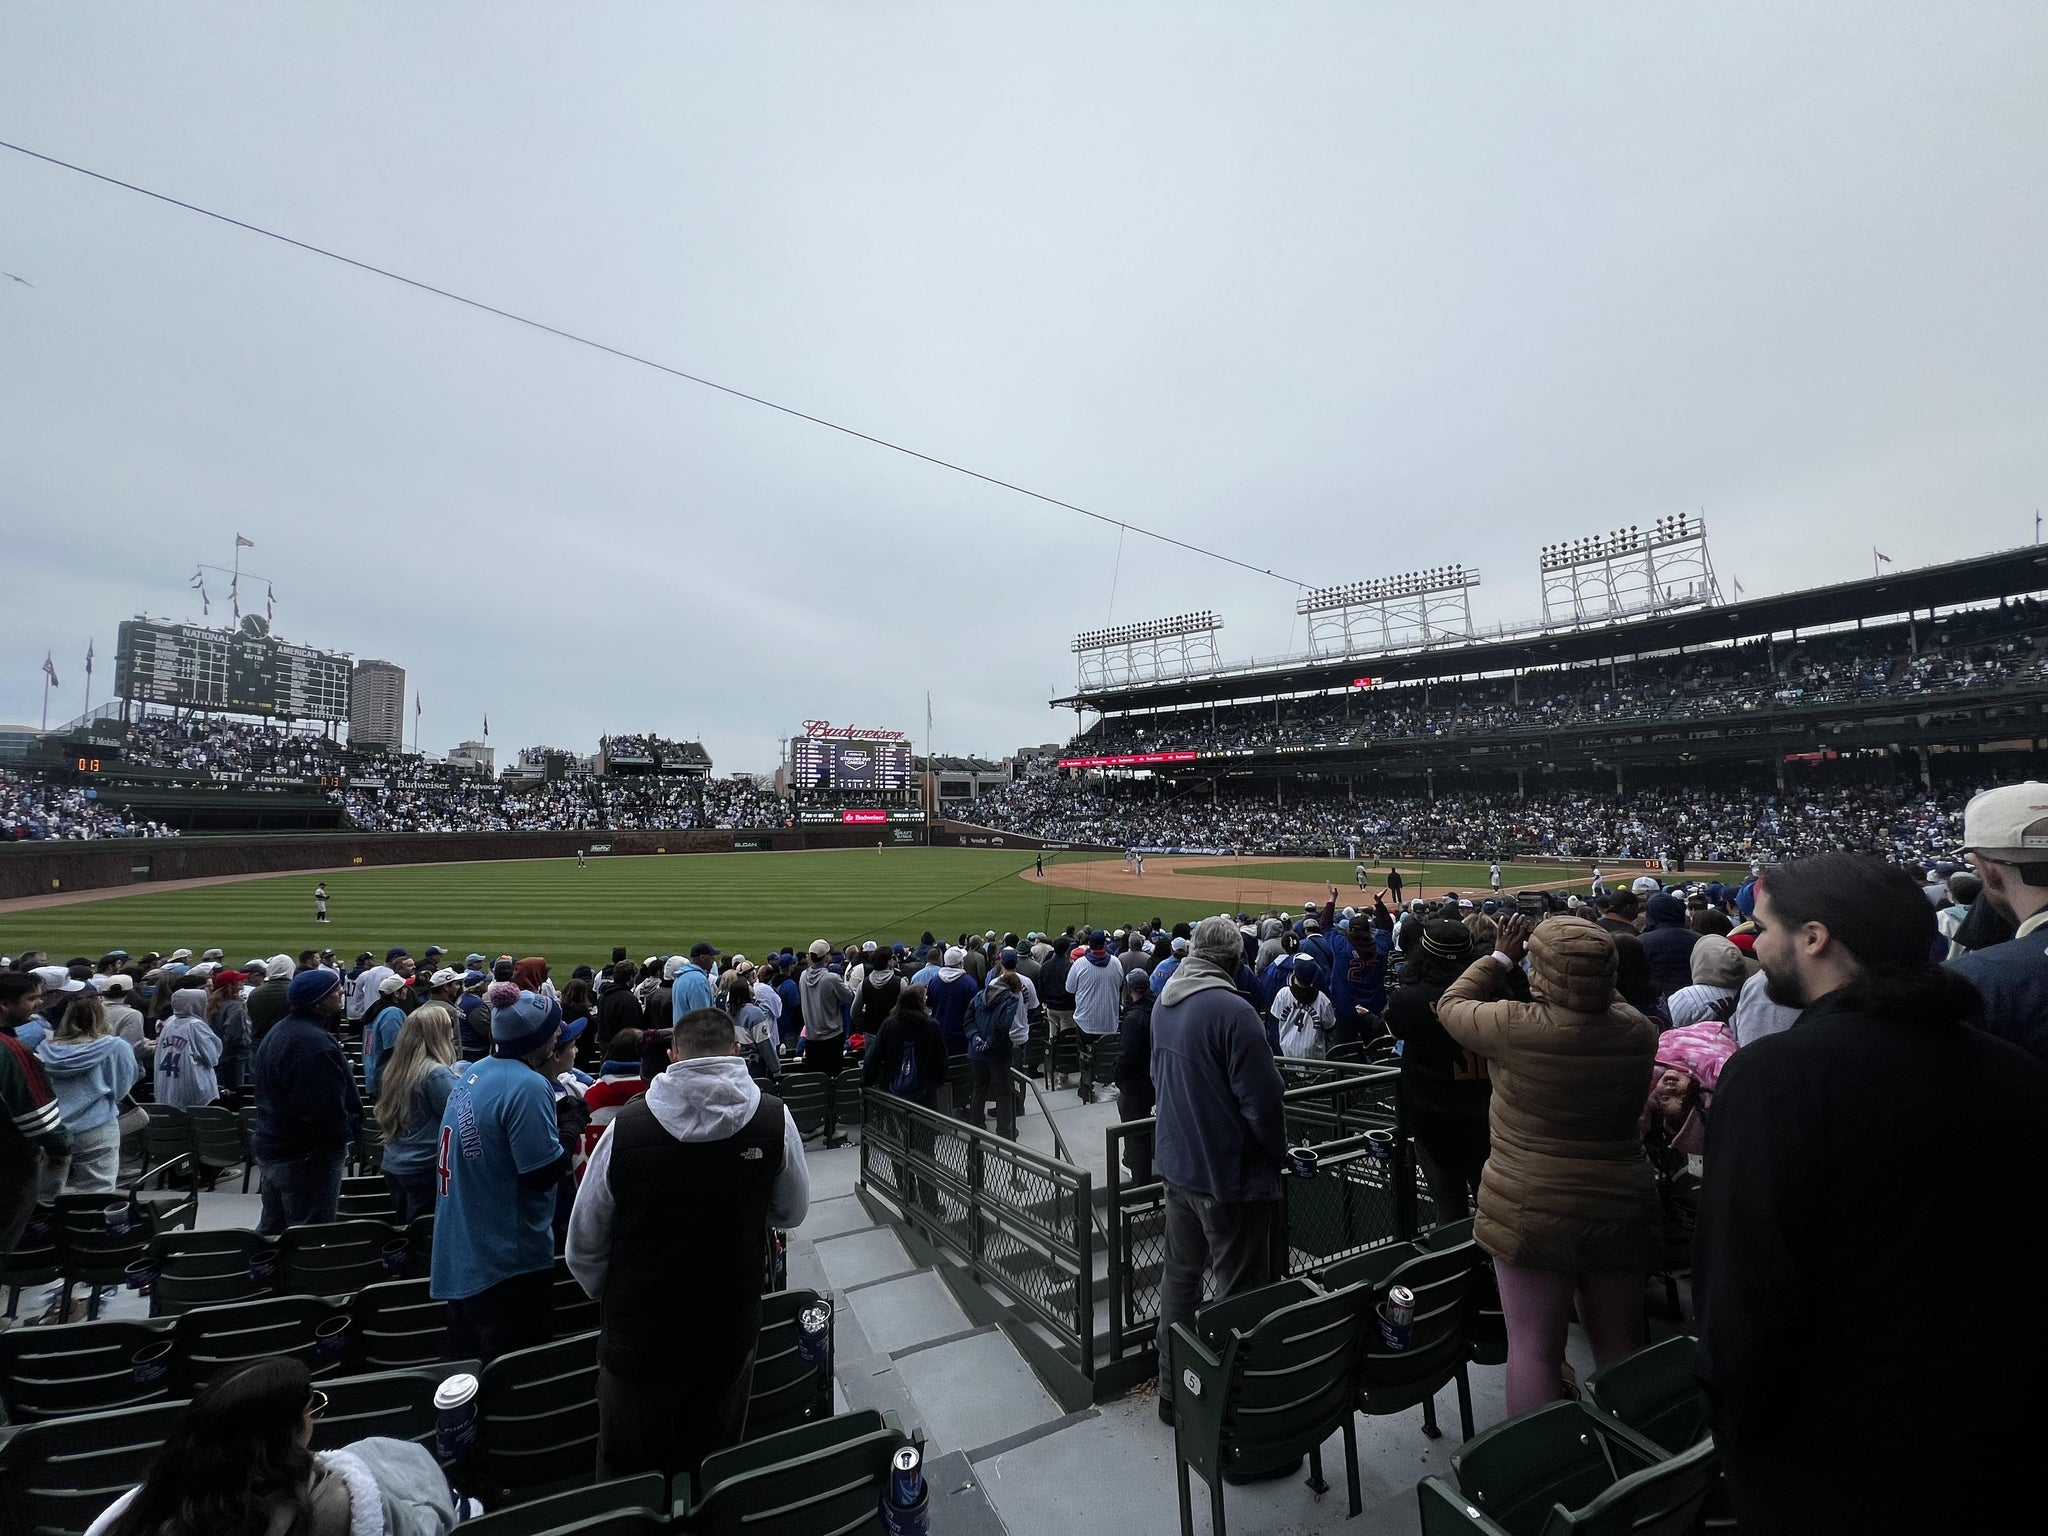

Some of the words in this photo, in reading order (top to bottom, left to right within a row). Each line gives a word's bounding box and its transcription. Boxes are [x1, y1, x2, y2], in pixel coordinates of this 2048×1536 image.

[182, 628, 231, 644] NATIONAL
[243, 653, 265, 662] BATTER
[276, 645, 318, 660] AMERICAN
[803, 720, 904, 740] Budweiser
[210, 771, 243, 782] YETI
[260, 776, 304, 784] tastytrade
[397, 780, 450, 790] Budweiser
[347, 981, 356, 997] 17
[160, 1052, 181, 1079] 44
[439, 1125, 453, 1197] 4
[1188, 1375, 1195, 1389] 5
